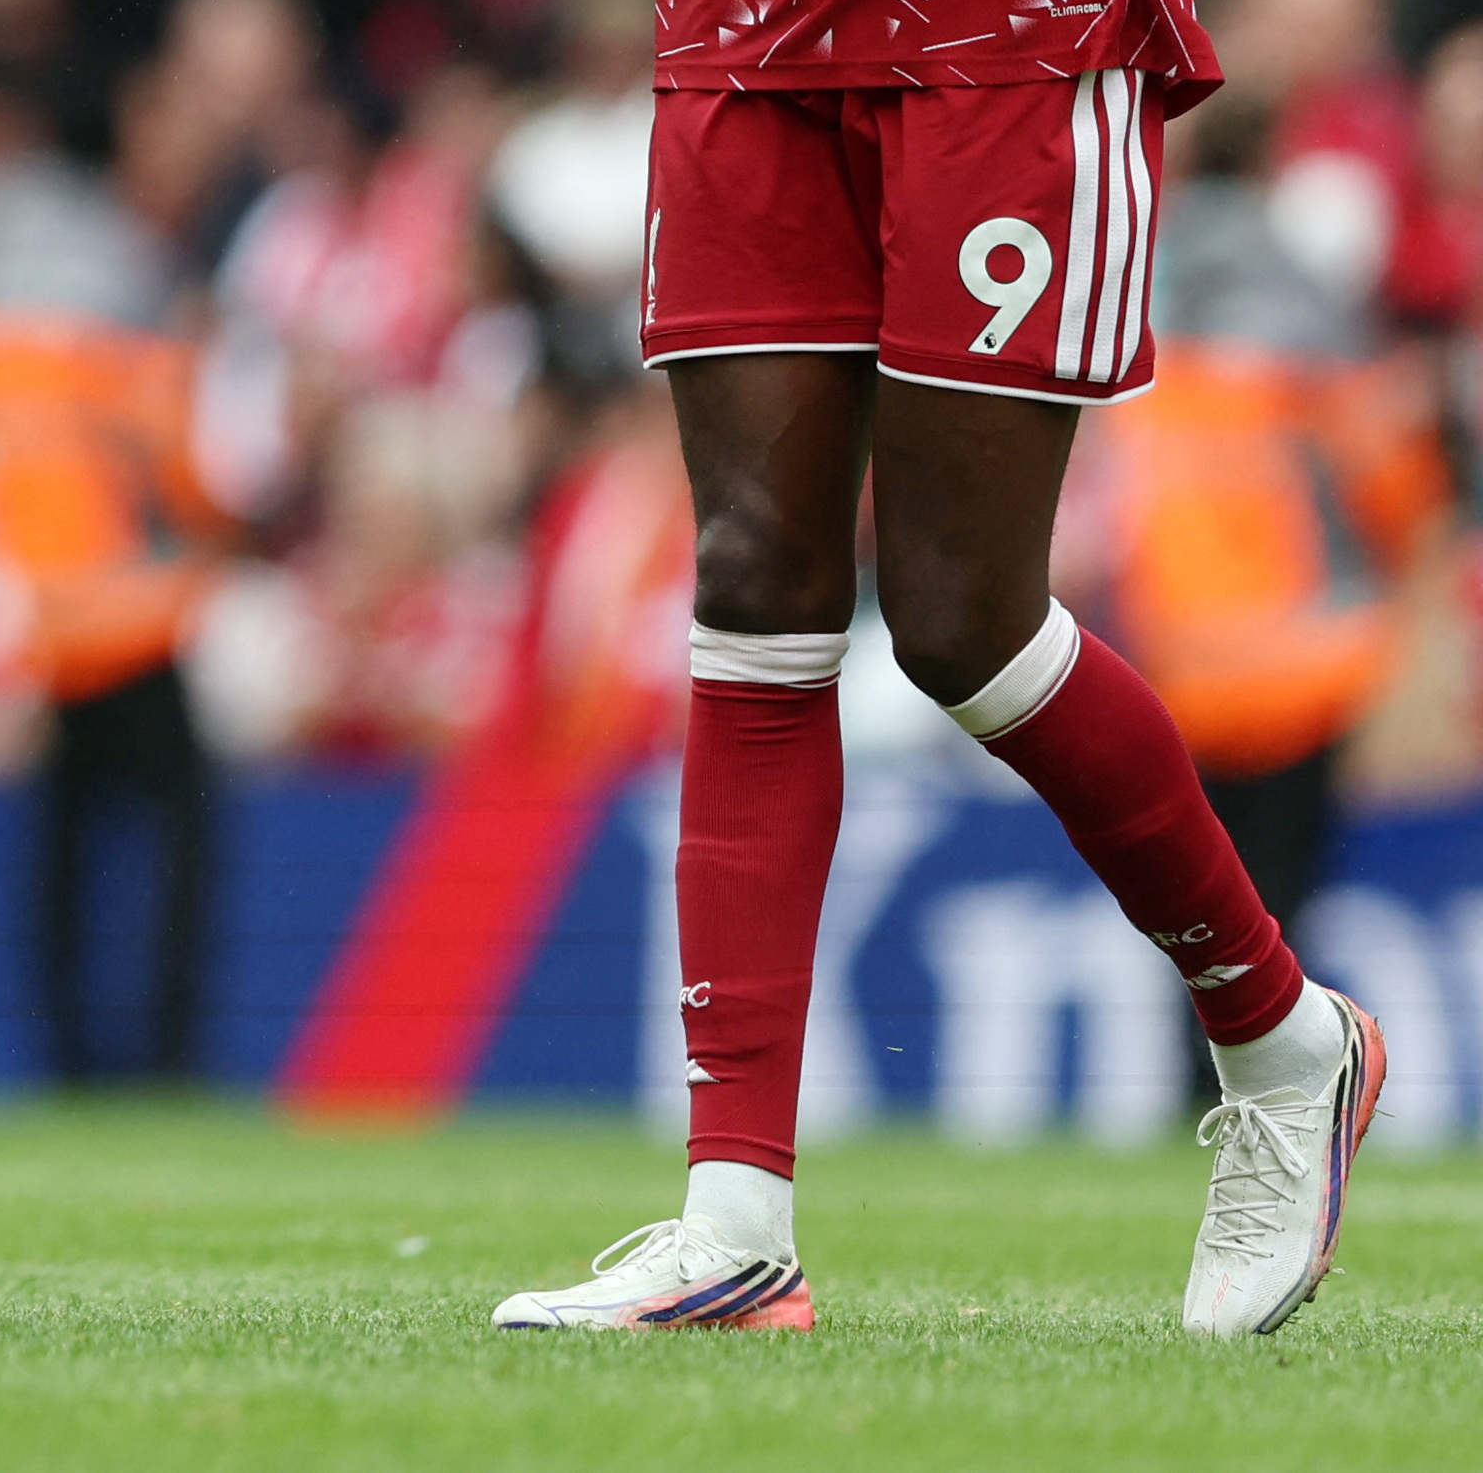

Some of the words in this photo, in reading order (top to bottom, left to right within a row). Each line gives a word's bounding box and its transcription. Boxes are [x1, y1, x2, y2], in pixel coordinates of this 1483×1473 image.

[958, 216, 1053, 355] 9
[1149, 923, 1214, 947] FC
[678, 980, 711, 1013] FC
